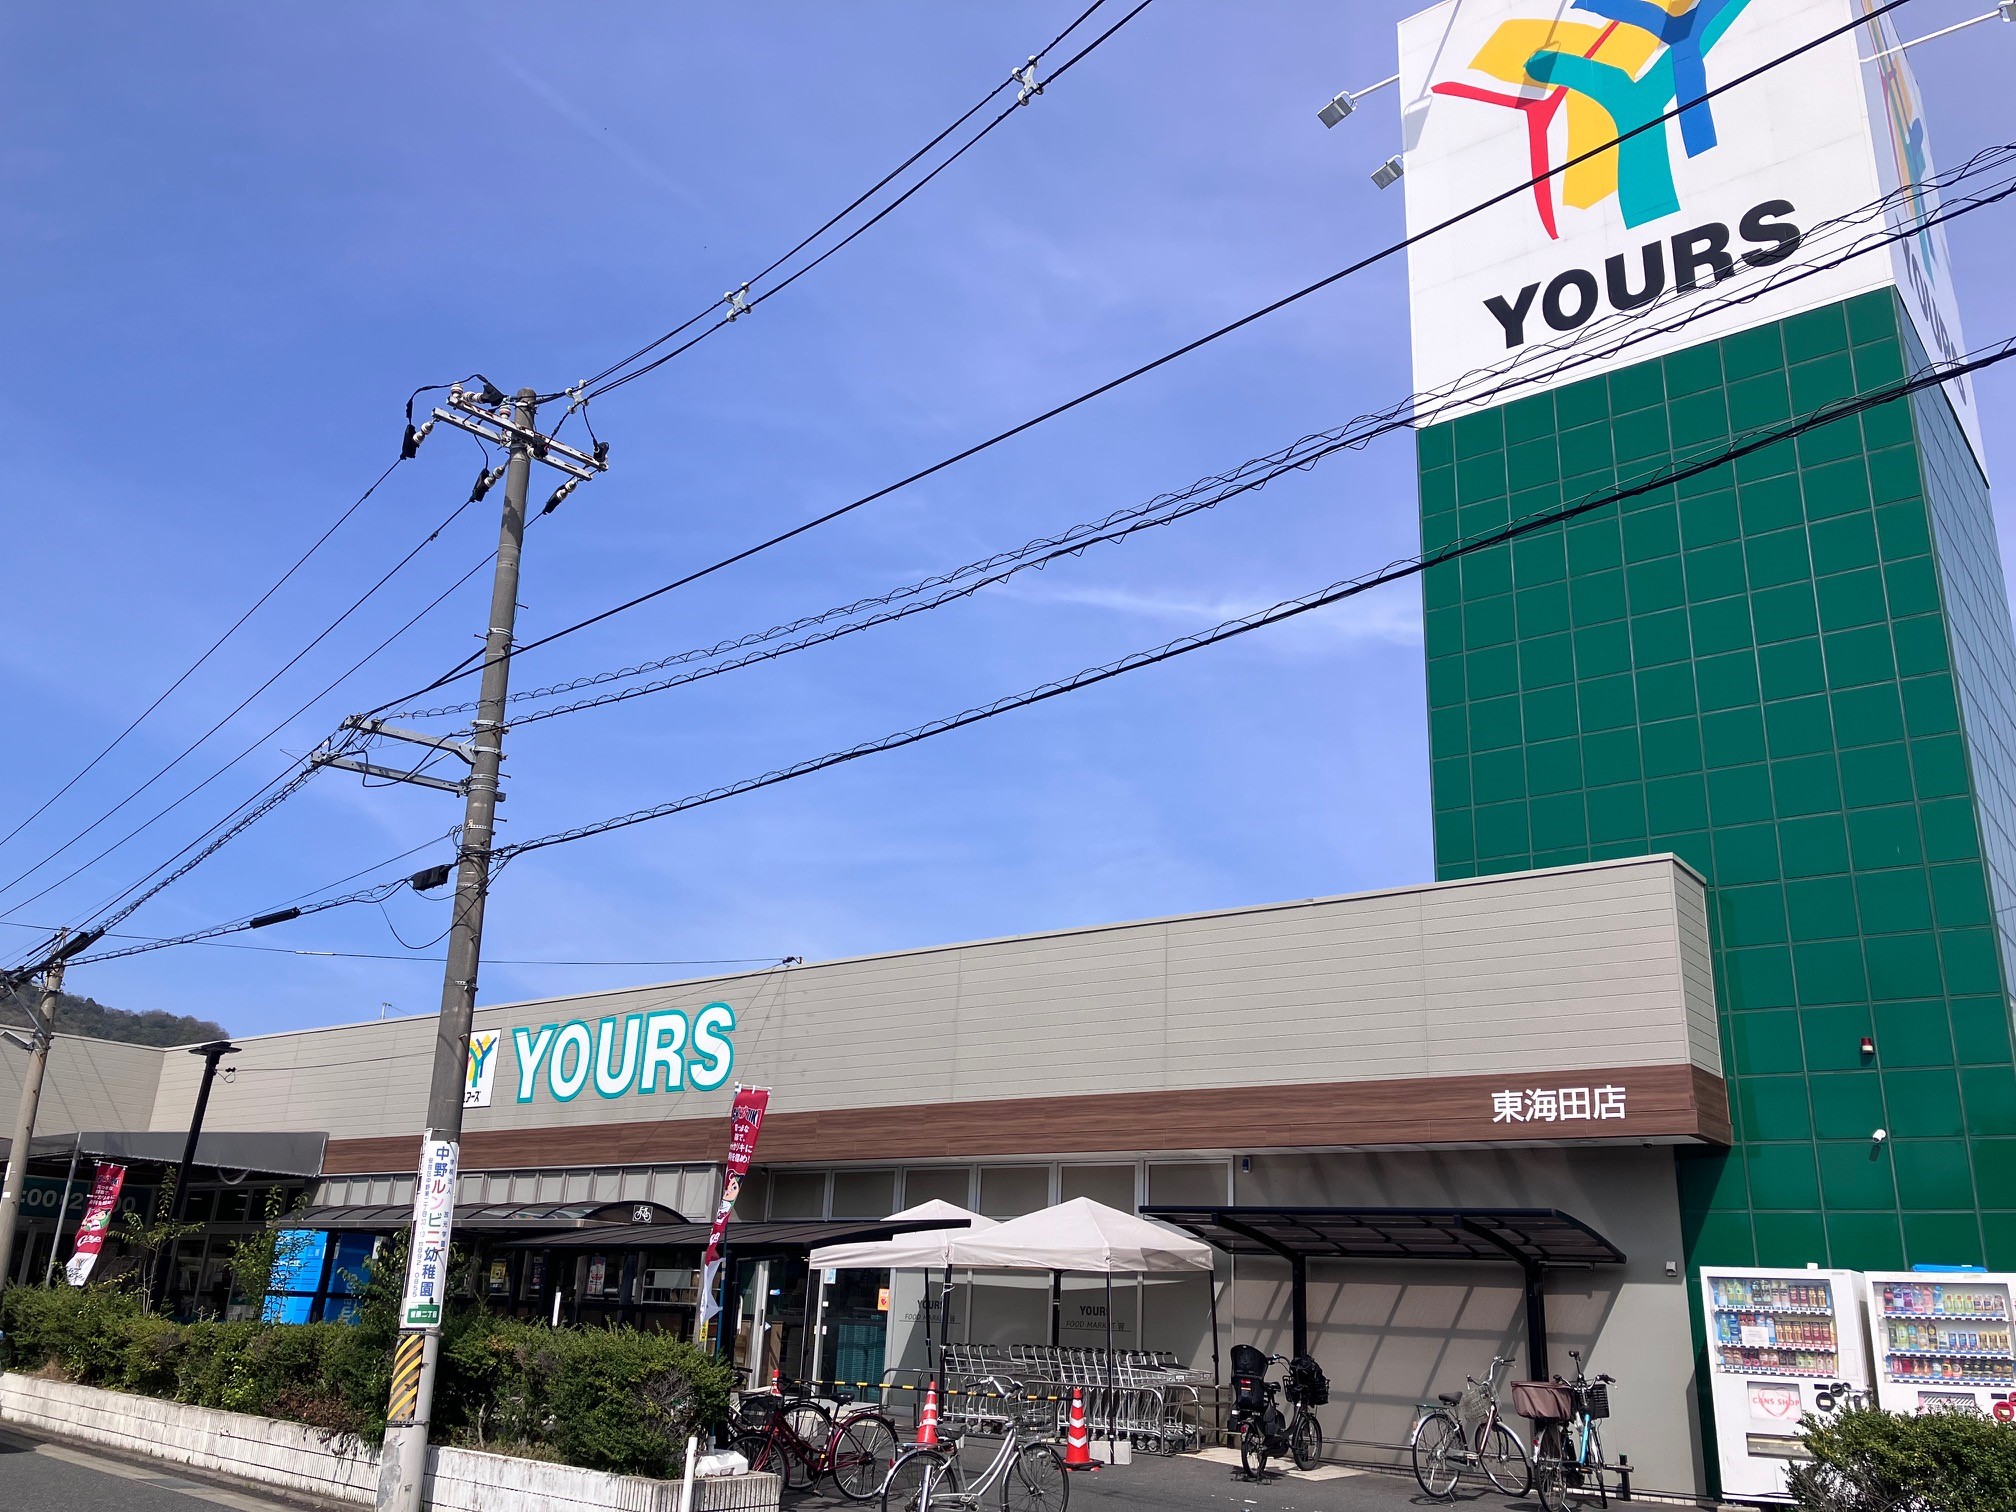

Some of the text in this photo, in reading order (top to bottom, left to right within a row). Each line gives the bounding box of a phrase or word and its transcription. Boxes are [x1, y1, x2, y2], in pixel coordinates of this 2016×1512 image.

[1483, 199, 1801, 349] YOURS
[512, 1002, 735, 1103] YOURS
[463, 1090, 481, 1103] アーズ
[1491, 1084, 1627, 1124] 東海田店
[419, 1145, 450, 1297] 中野ルンビニ幼稚園
[1079, 1305, 1108, 1317] YOUR
[1066, 1320, 1116, 1329] FOOD MARKT
[1752, 1397, 1800, 1406] CANS SHOP
